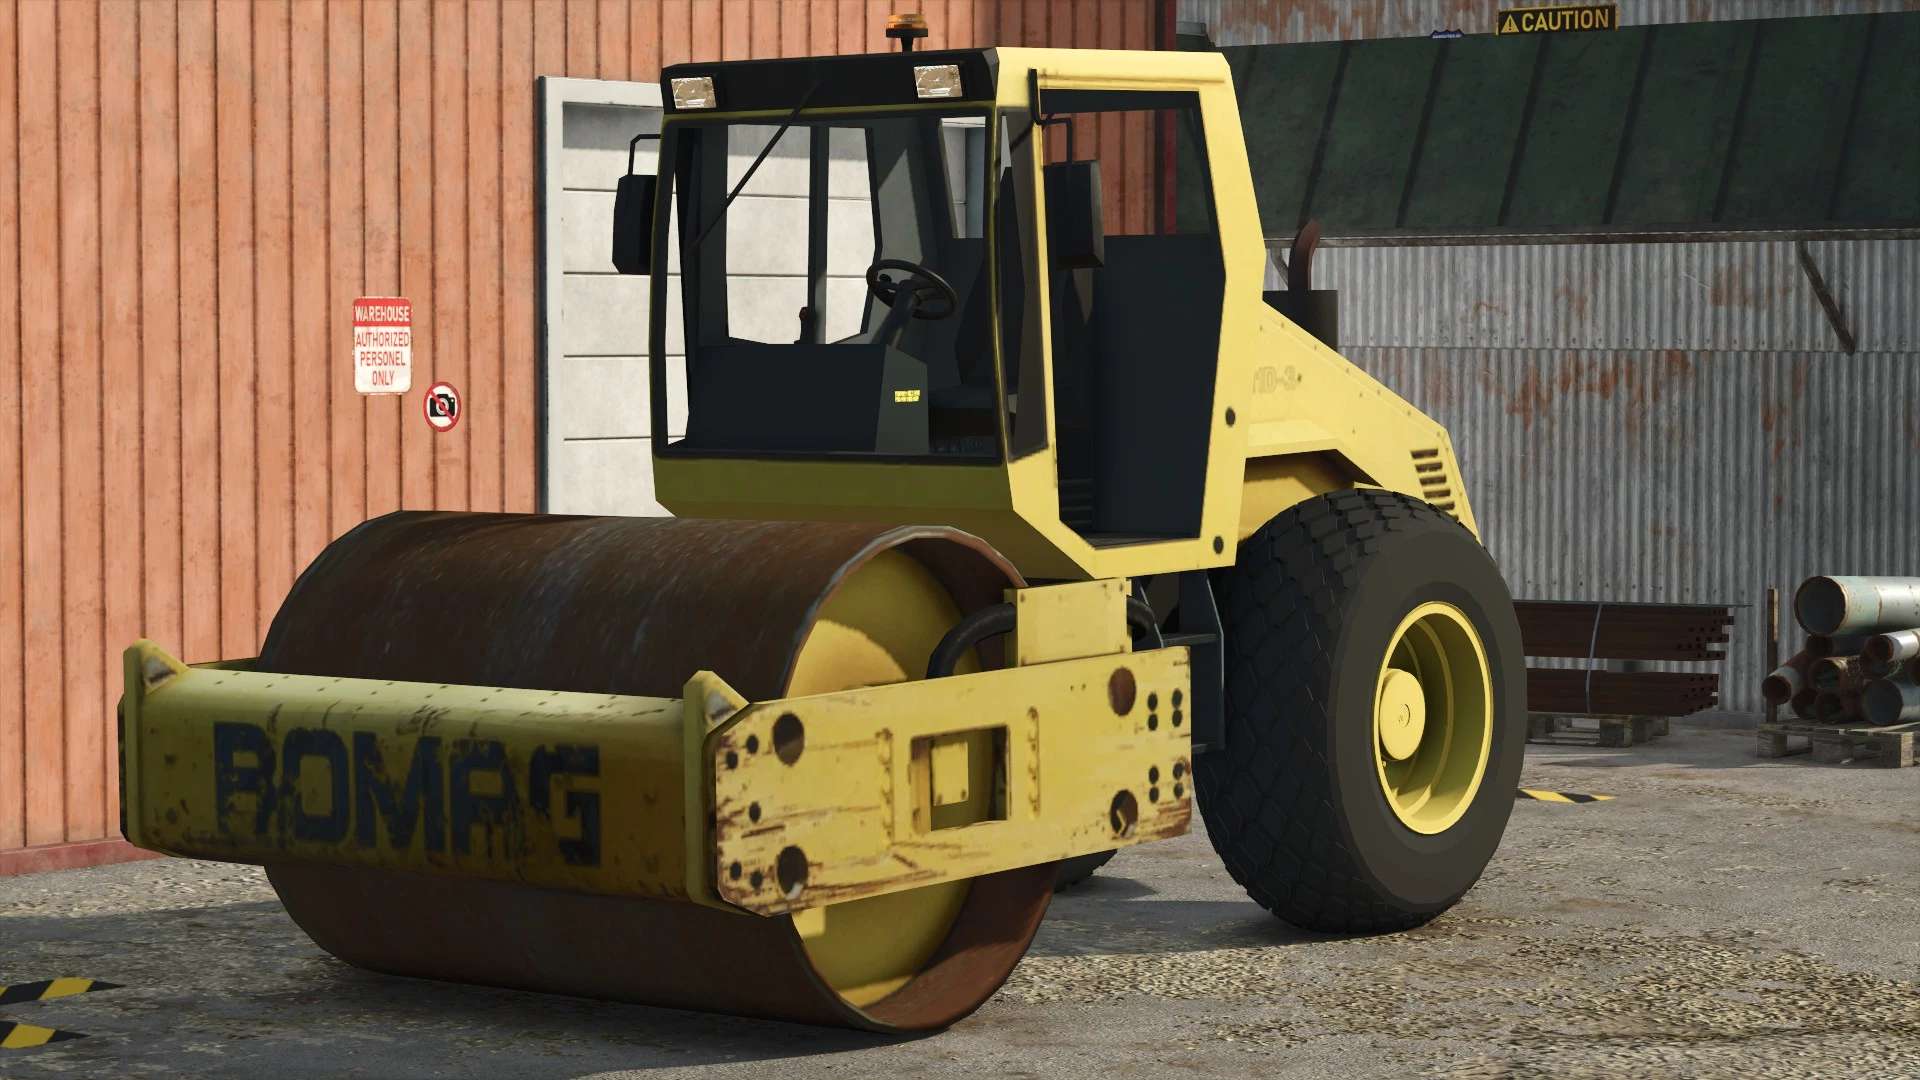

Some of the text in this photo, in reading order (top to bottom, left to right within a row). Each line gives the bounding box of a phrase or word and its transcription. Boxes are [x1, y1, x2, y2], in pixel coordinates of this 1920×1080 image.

[1521, 8, 1609, 32] CAUTION
[354, 305, 410, 322] WAREHOUSE
[355, 331, 410, 347] AUTHORIZED
[360, 351, 406, 367] PERSONEL
[372, 370, 395, 386] ONLY
[213, 721, 600, 867] BOMAG
